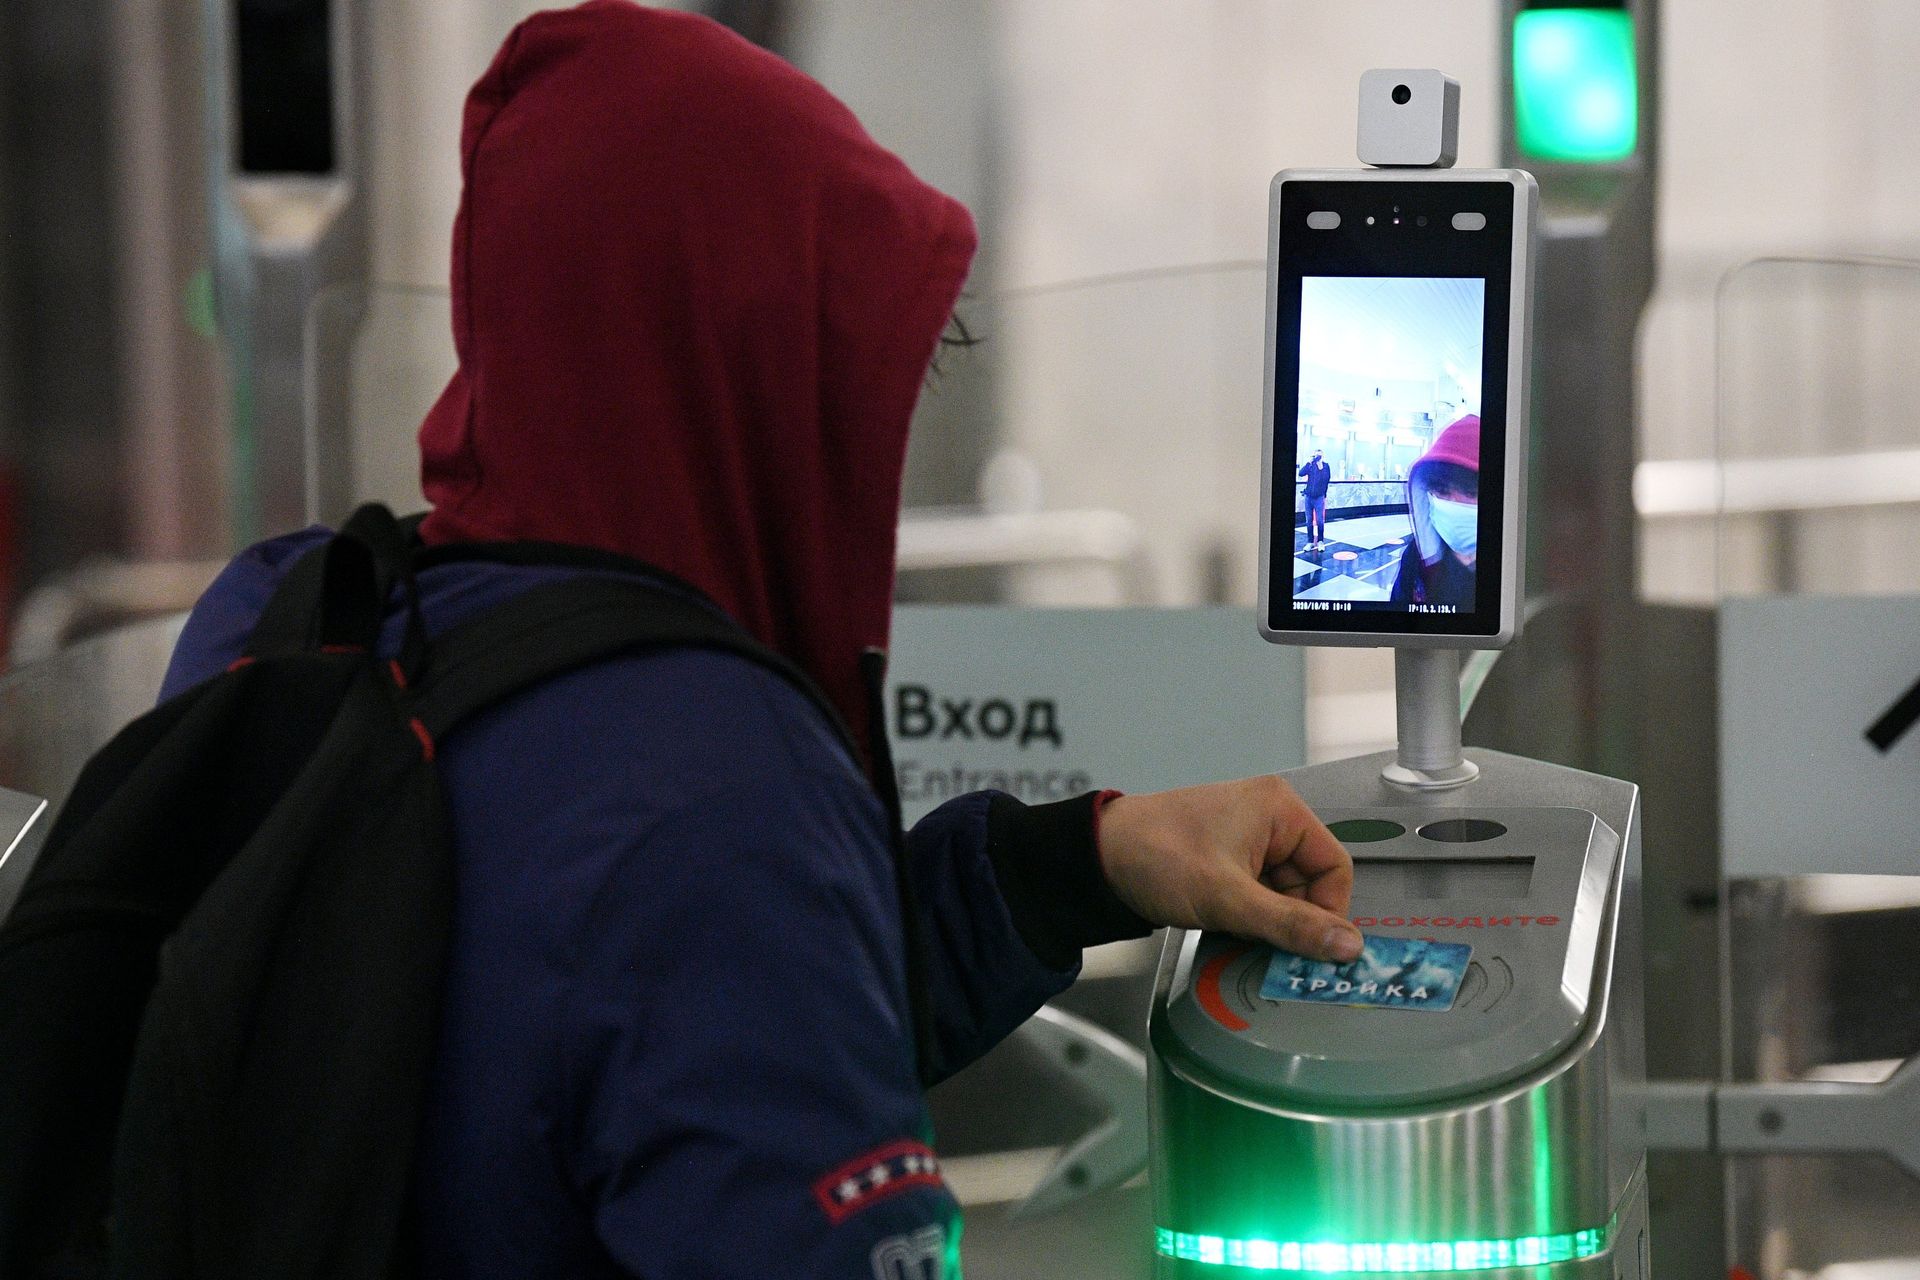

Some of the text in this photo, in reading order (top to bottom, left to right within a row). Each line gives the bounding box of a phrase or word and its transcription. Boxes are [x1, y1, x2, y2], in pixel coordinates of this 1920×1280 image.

[896, 685, 1062, 748] Вход
[899, 760, 1091, 798] Entrance
[1351, 916, 1560, 929] роходите
[1289, 976, 1428, 999] ТРОЙКА
